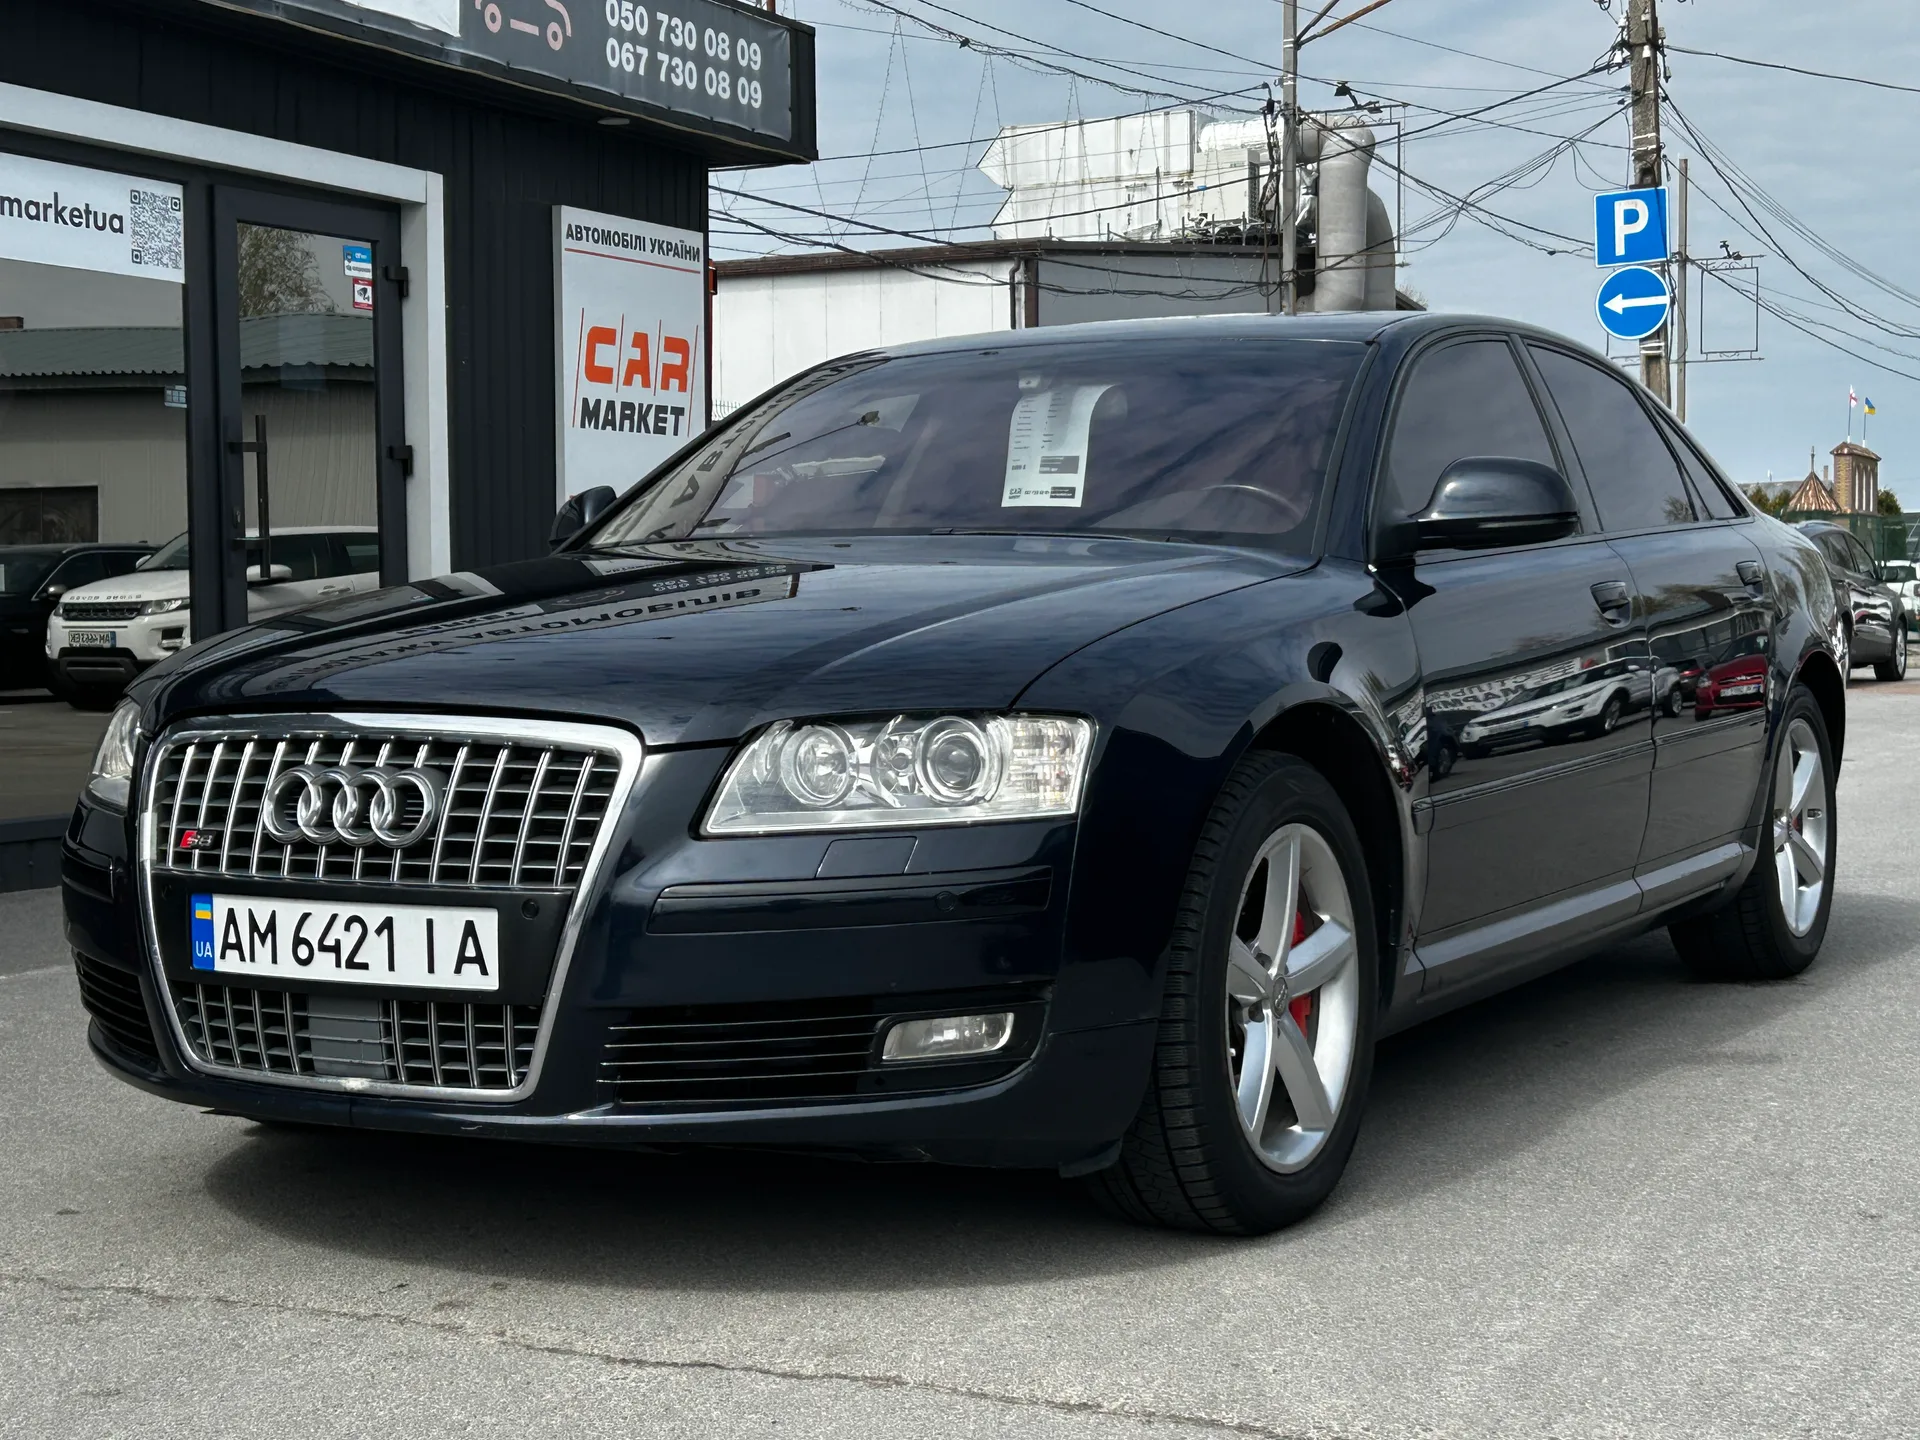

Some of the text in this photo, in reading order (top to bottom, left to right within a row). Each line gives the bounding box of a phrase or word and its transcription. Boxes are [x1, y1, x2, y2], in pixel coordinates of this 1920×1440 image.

[606, 0, 761, 71] 050 730 08 09
[606, 37, 762, 109] 067 730 08 09
[0, 191, 124, 234] marketua
[1614, 198, 1649, 256] P
[566, 223, 700, 263] АВТОМОБІЛІ УКРАЇНИ
[584, 325, 690, 393] CAR
[580, 397, 685, 436] MARKET
[196, 940, 213, 959] UA
[219, 907, 278, 965] AM
[292, 912, 395, 972] 6421
